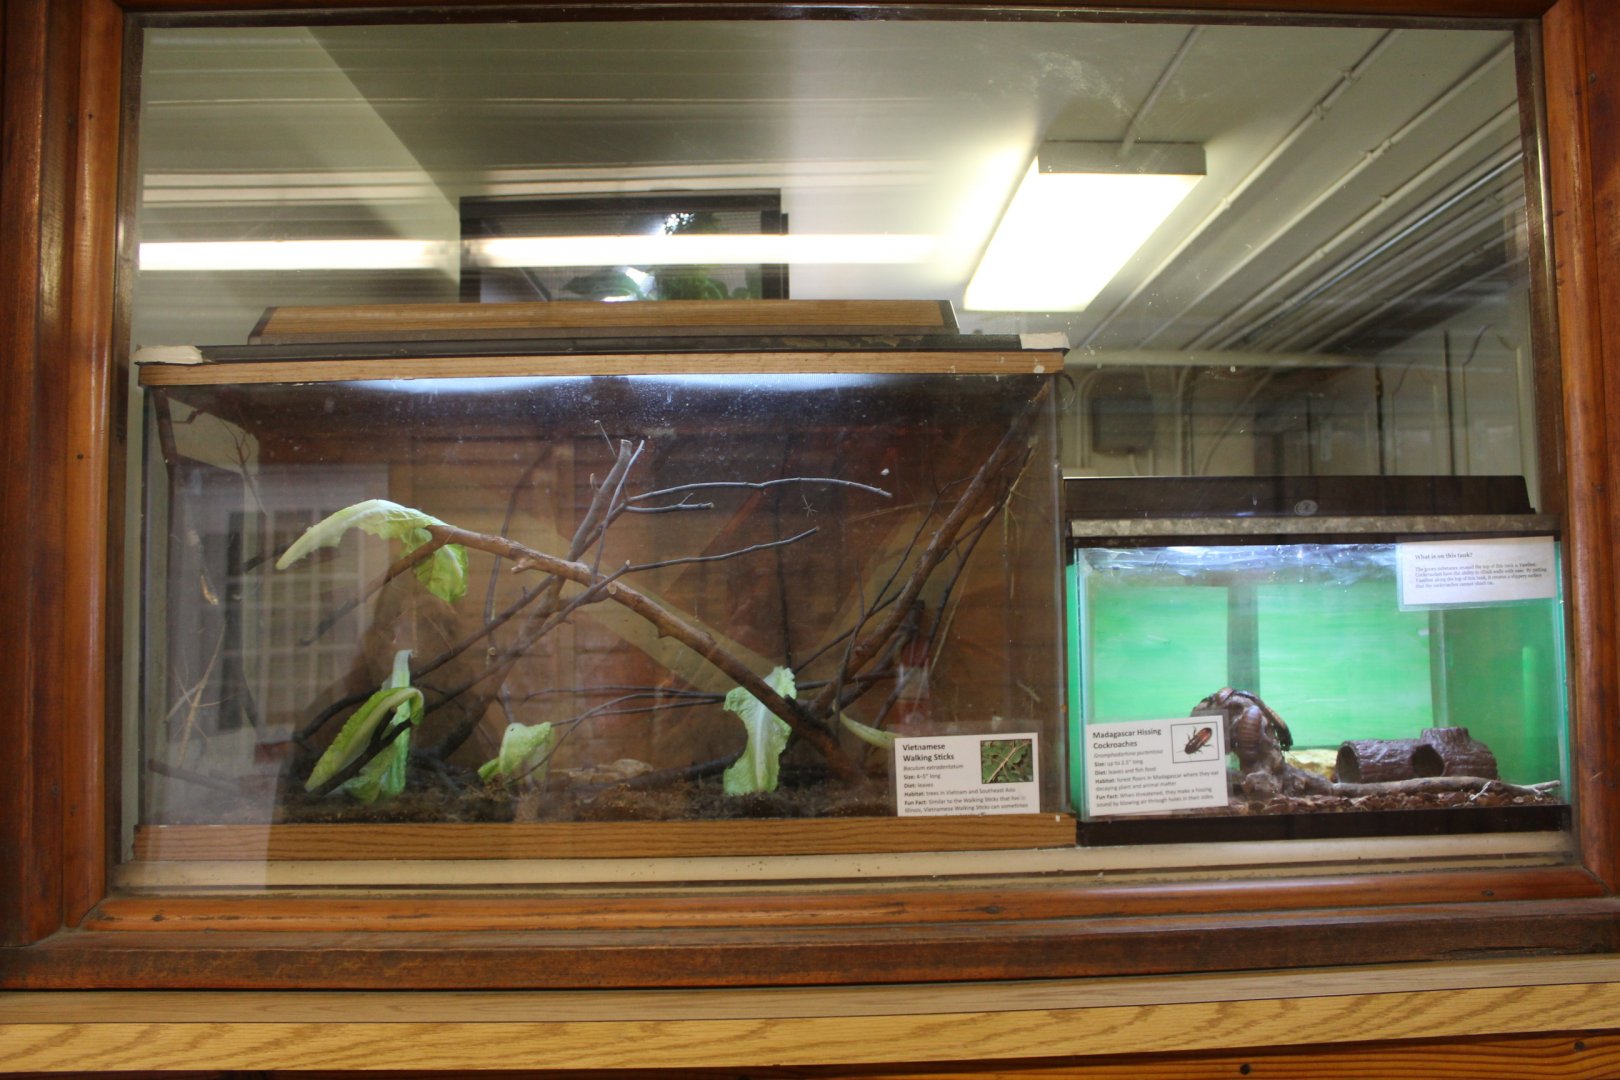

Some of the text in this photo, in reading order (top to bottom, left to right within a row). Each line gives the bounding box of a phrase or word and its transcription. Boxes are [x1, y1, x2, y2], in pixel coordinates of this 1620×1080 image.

[1092, 728, 1162, 739] Madagascar Hissing
[902, 743, 945, 751] Vietnamese
[1093, 741, 1137, 749] Cockroaches
[903, 753, 954, 762] Walking Sticks
